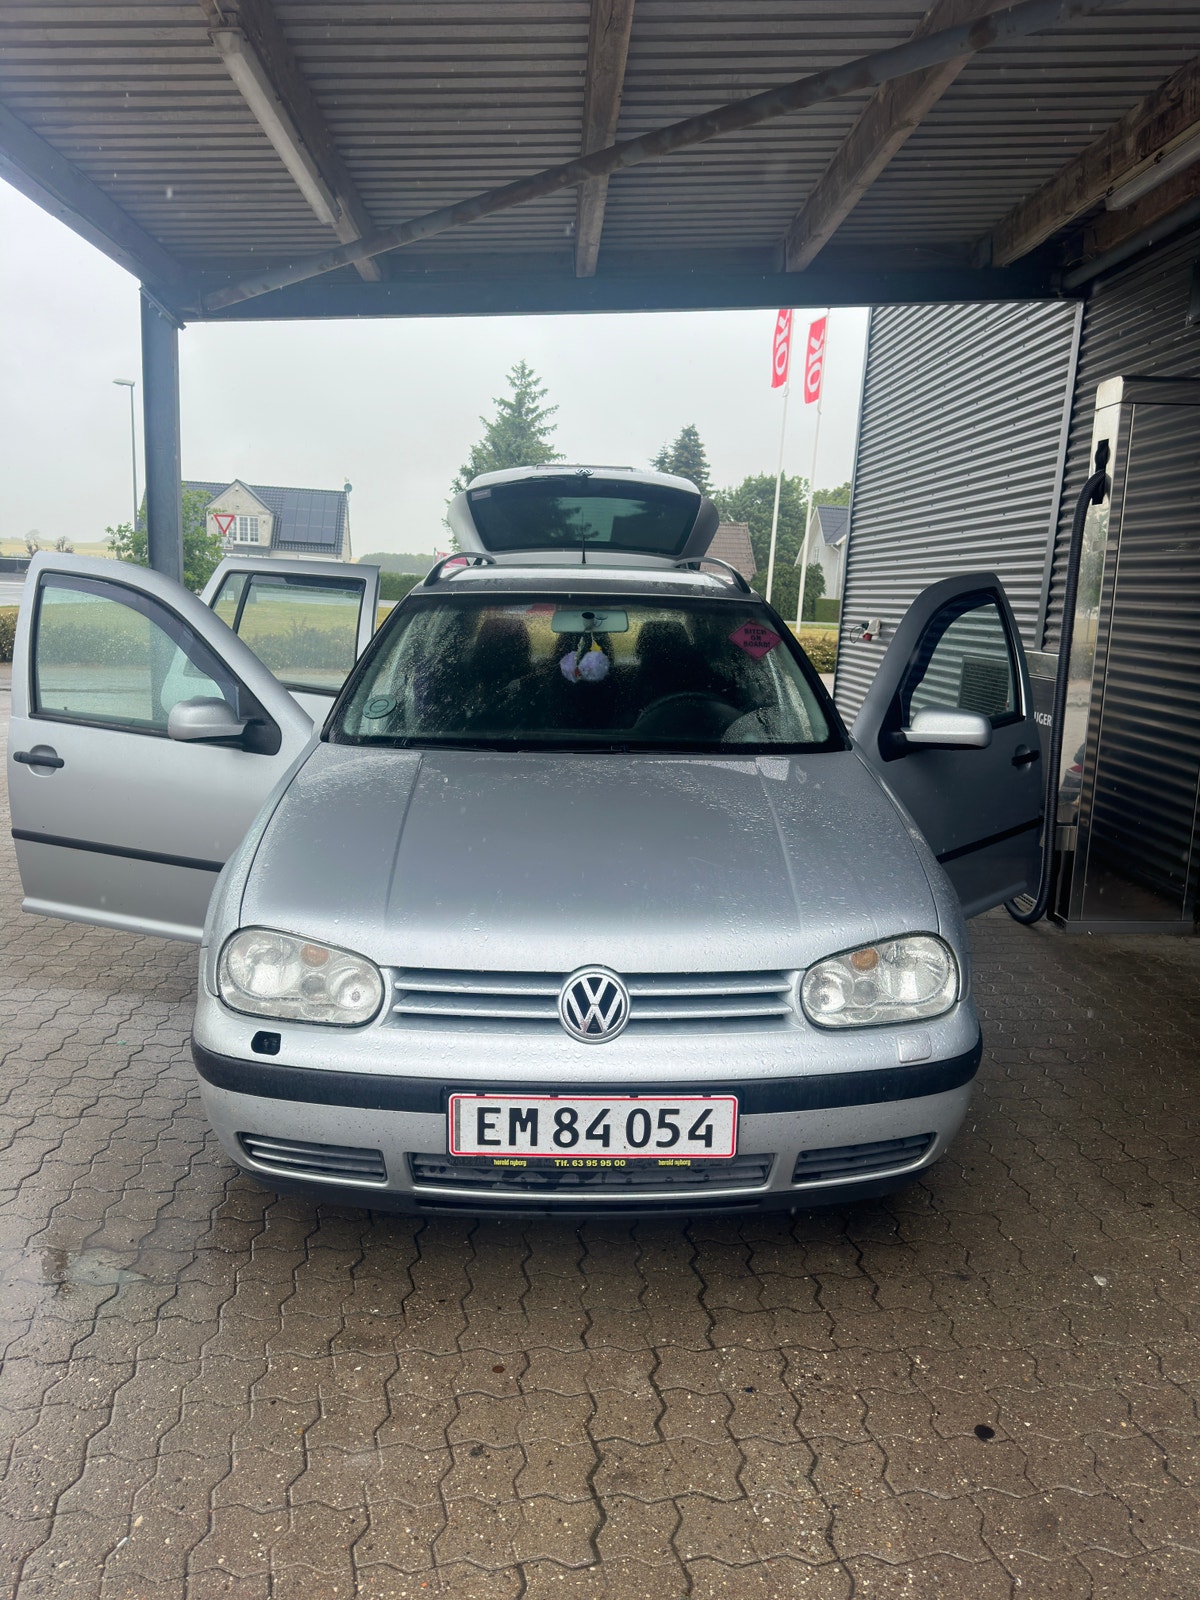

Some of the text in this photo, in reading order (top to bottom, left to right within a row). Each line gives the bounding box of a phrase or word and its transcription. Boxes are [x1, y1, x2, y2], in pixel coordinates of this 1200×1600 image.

[1034, 711, 1052, 727] UGER
[477, 1107, 714, 1148] EM 84 054
